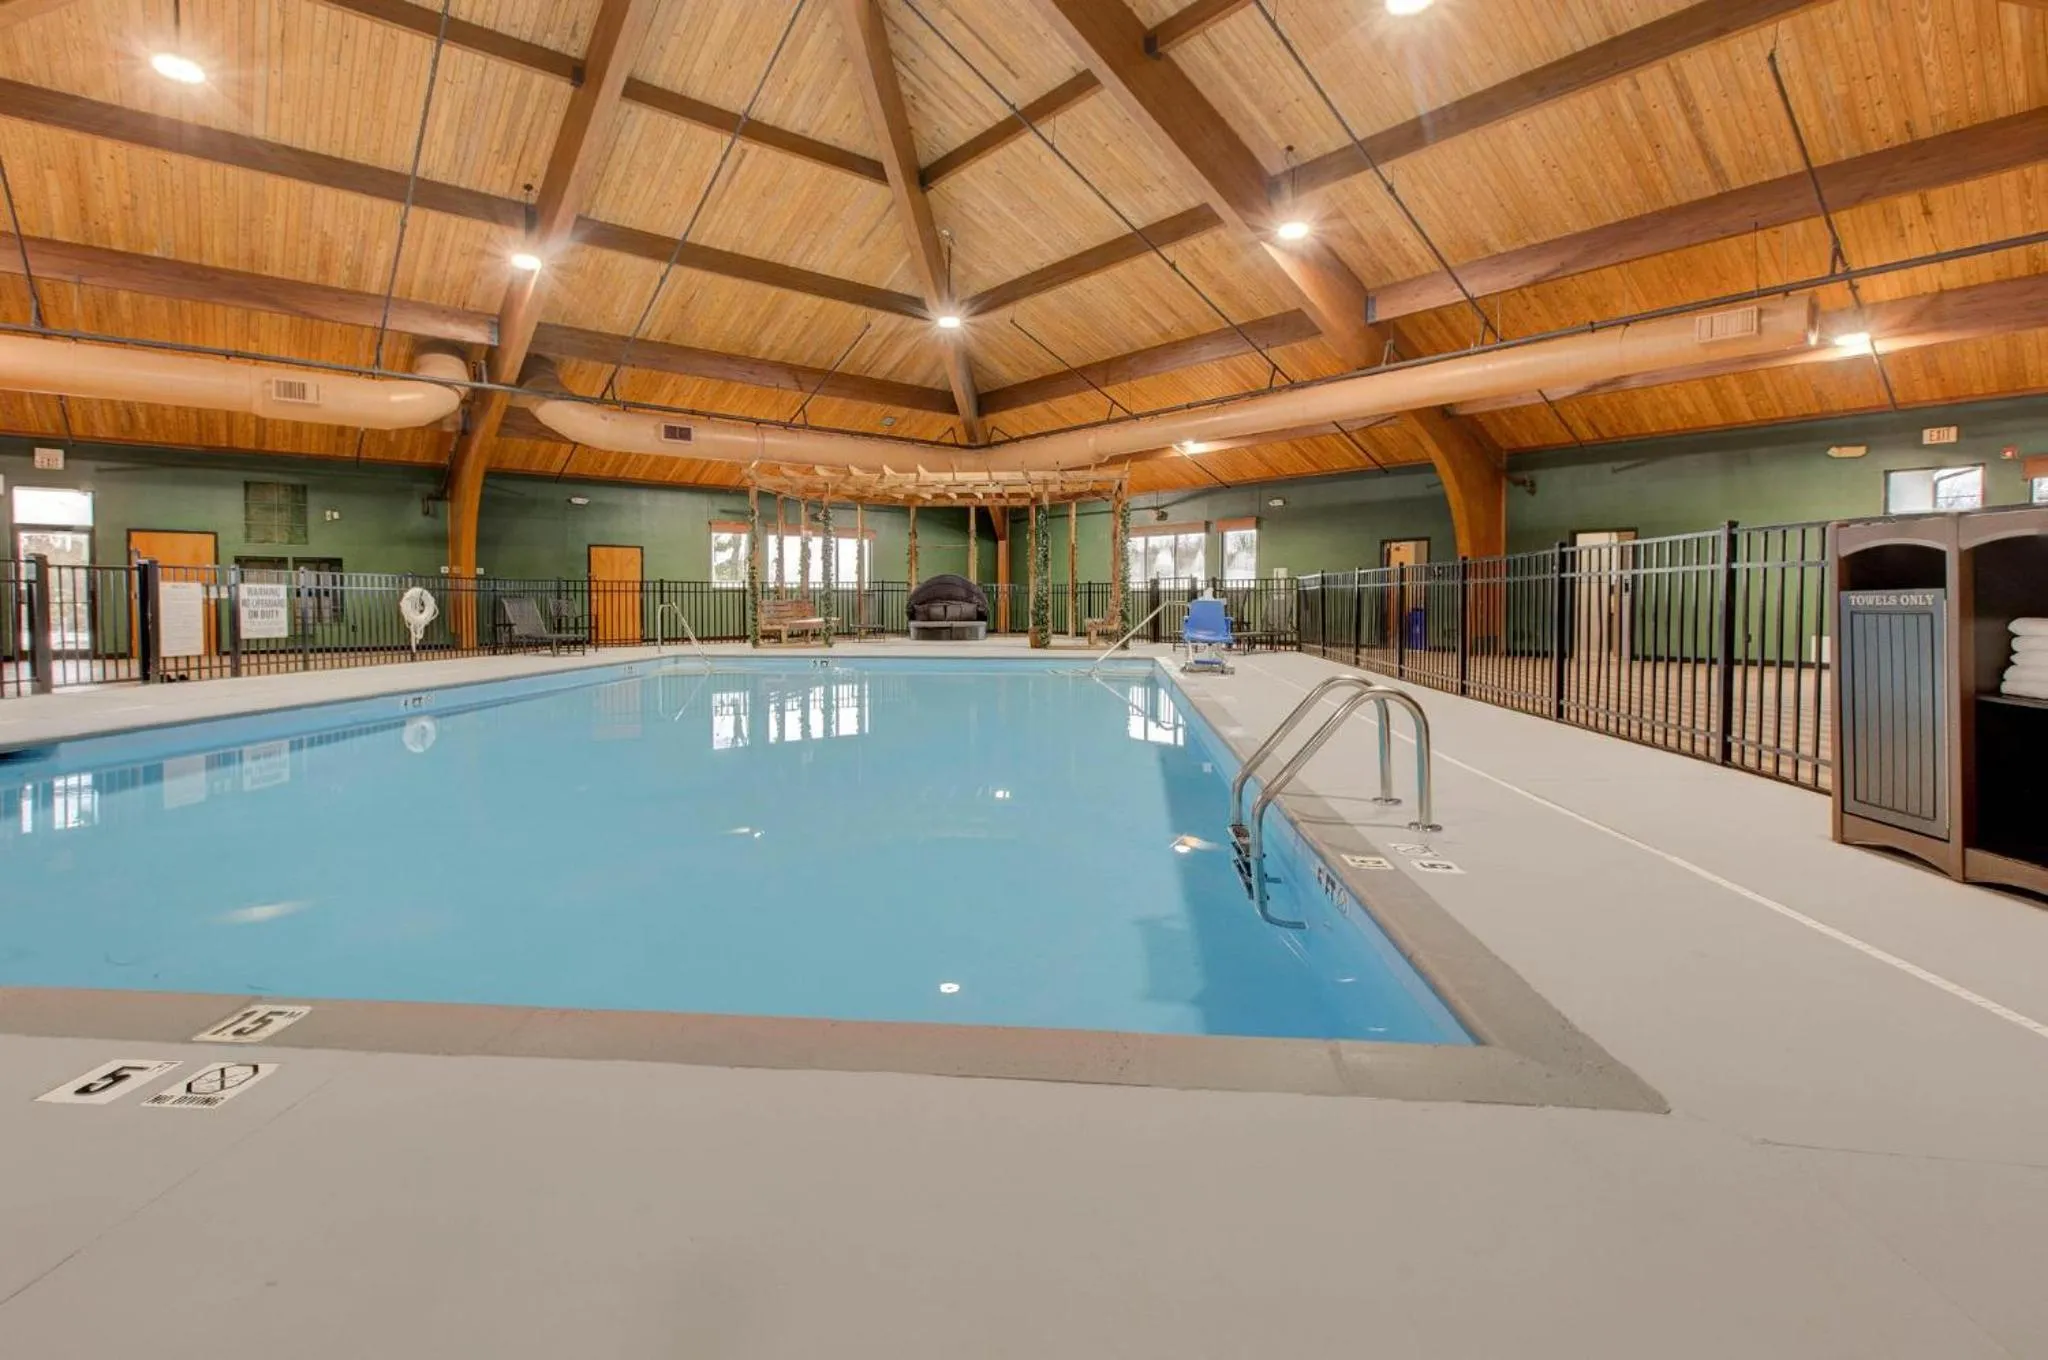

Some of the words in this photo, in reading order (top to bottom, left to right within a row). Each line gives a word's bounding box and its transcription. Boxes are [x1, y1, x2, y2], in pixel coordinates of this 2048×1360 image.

[1850, 594, 1897, 606] TOWELS
[1900, 593, 1935, 606] ONLY
[73, 1065, 149, 1096] 5
